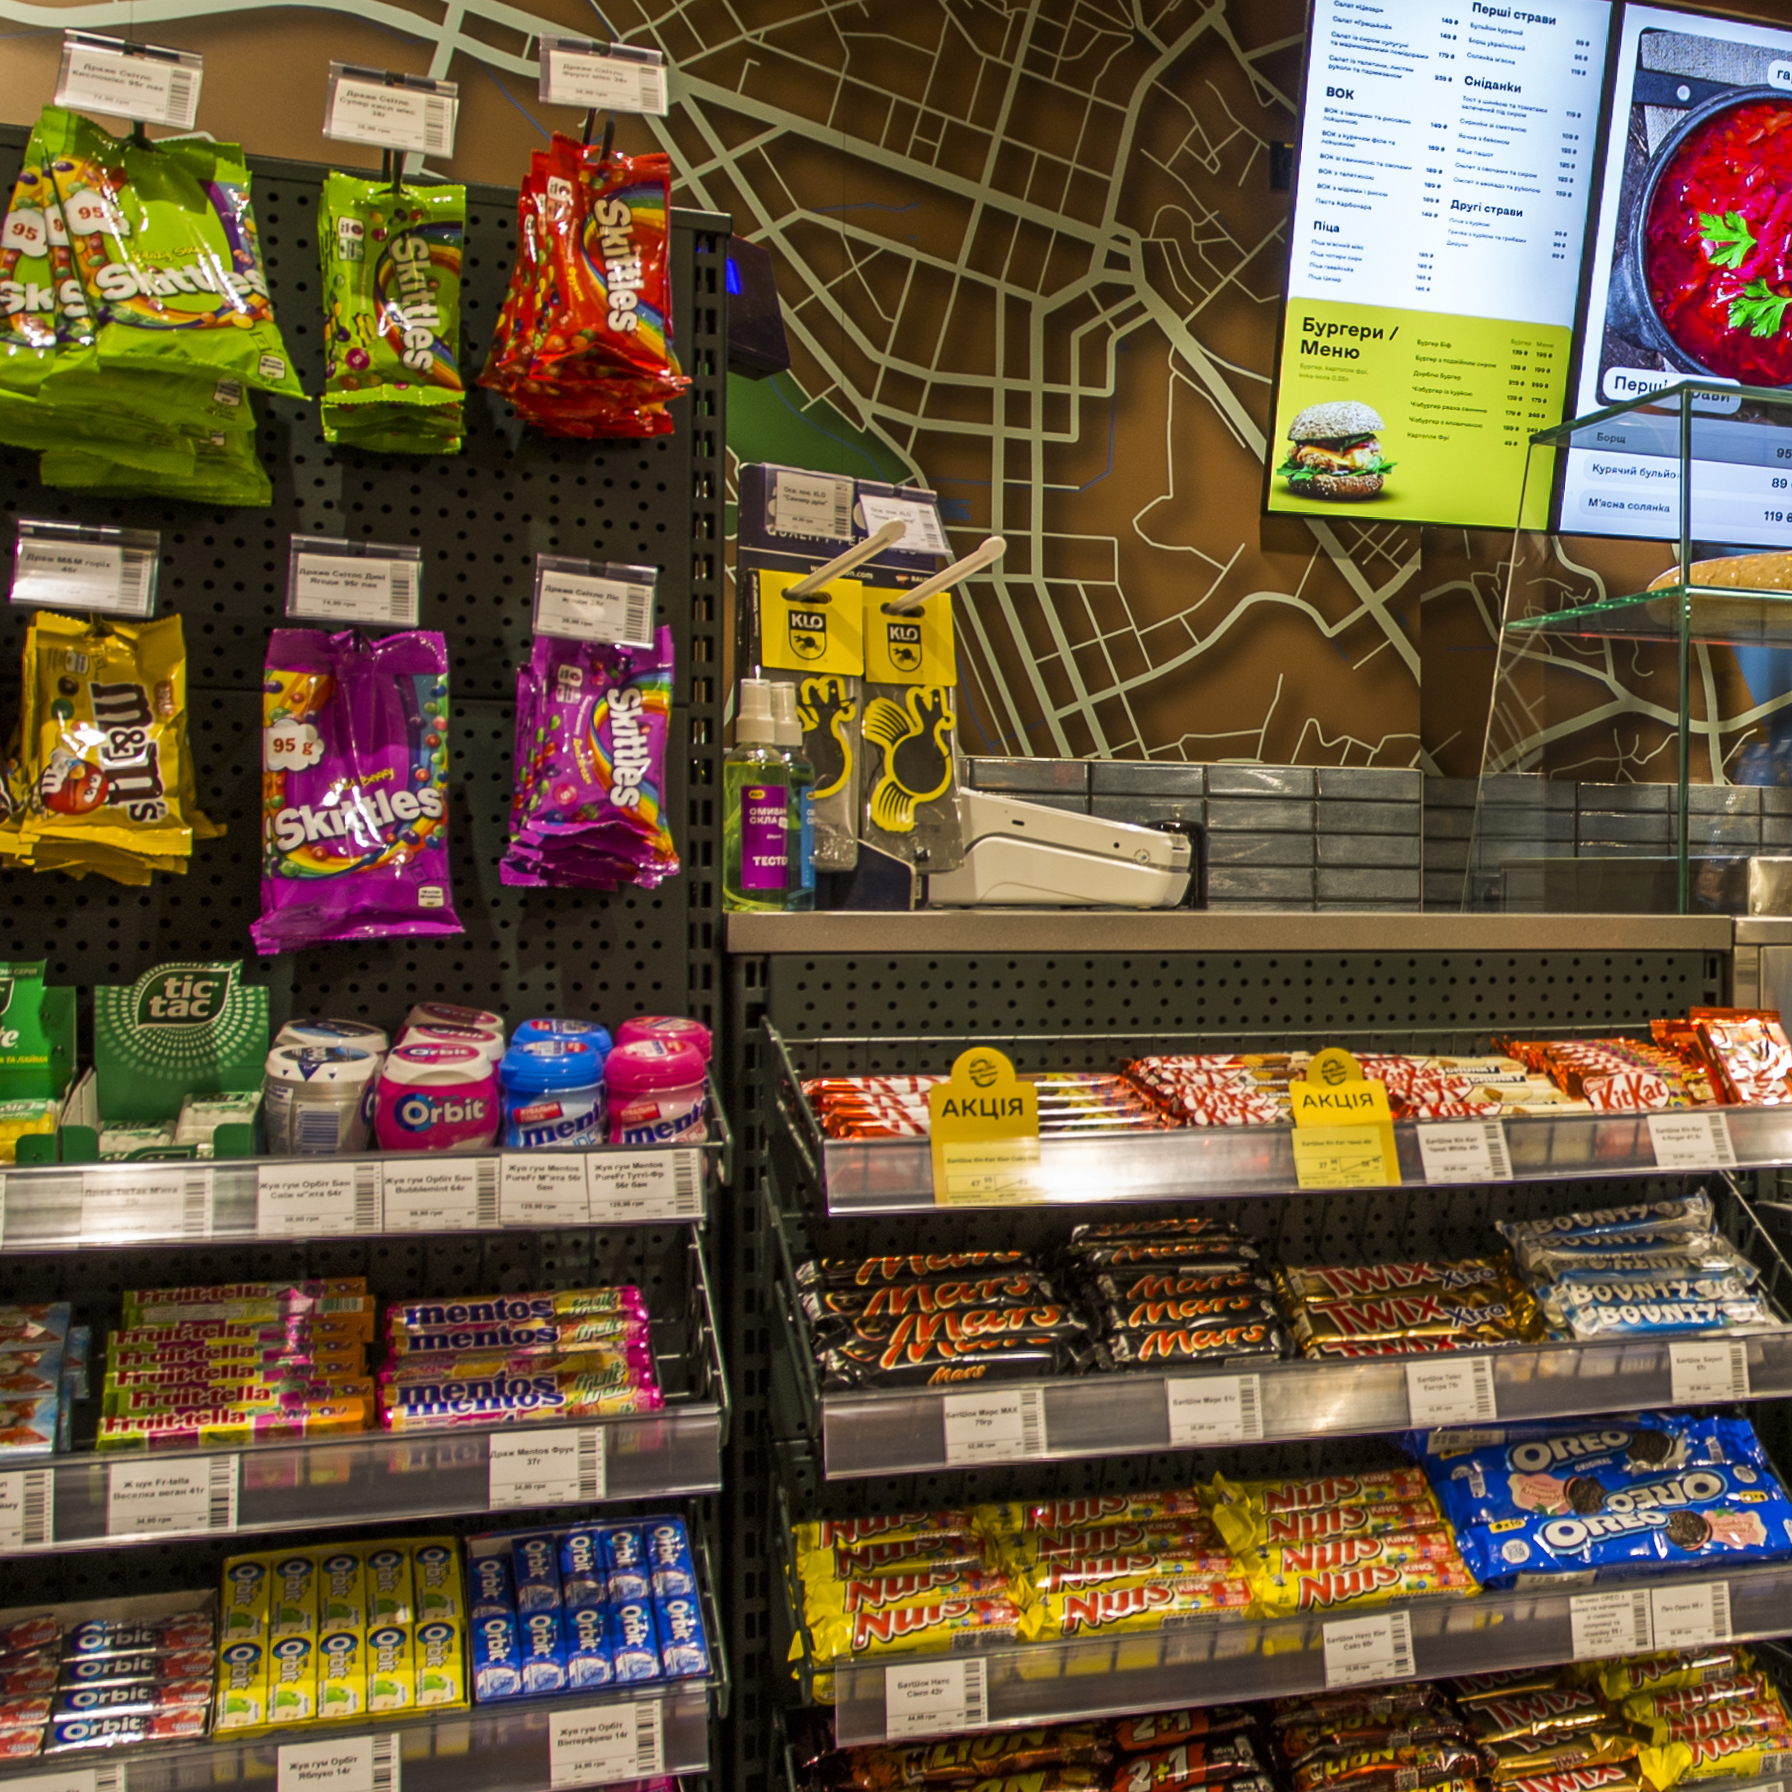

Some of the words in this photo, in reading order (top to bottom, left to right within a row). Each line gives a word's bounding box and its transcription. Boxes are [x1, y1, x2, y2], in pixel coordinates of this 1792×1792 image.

[1471, 1, 1511, 17] Перші
[1513, 8, 1557, 26] страви
[1325, 86, 1354, 101] ВОК
[1464, 75, 1522, 94] Сніданки
[1449, 199, 1482, 215] Другі
[1483, 202, 1524, 218] страви
[11, 222, 39, 241] 95
[1313, 219, 1340, 234] Піца
[390, 236, 440, 371] Skittles
[1302, 316, 1384, 342] Бургери
[1388, 326, 1399, 341] /
[1300, 339, 1360, 360] Меню
[1596, 431, 1627, 445] Борщ
[1627, 500, 1671, 514] солянка
[272, 736, 296, 754] 95
[302, 740, 314, 756] g
[164, 975, 214, 1000] tic
[149, 995, 211, 1018] tac
[1466, 1073, 1526, 1085] CHUNKY
[1302, 1091, 1374, 1110] АКЦІЯ
[1598, 1074, 1667, 1108] KitKat
[395, 1092, 485, 1133] Orbit
[942, 1098, 1024, 1118] АКЦІЯ
[548, 1164, 579, 1173] Mentos
[1437, 1265, 1496, 1291] Xtra
[133, 1284, 268, 1304] Fruit-tella
[863, 1274, 1030, 1318] Mars
[408, 1323, 559, 1351] mentos
[518, 1447, 548, 1457] Mentos
[1510, 1430, 1631, 1474] OREO
[1574, 1456, 1613, 1473] ORIGINAL
[113, 1487, 154, 1500] Веселка
[1178, 1583, 1208, 1595] KING
[558, 1735, 613, 1748] Вінтерфреш
[311, 1760, 328, 1770] гум
[330, 1755, 358, 1767] Орбіт
[298, 1769, 335, 1781] Яблуко
